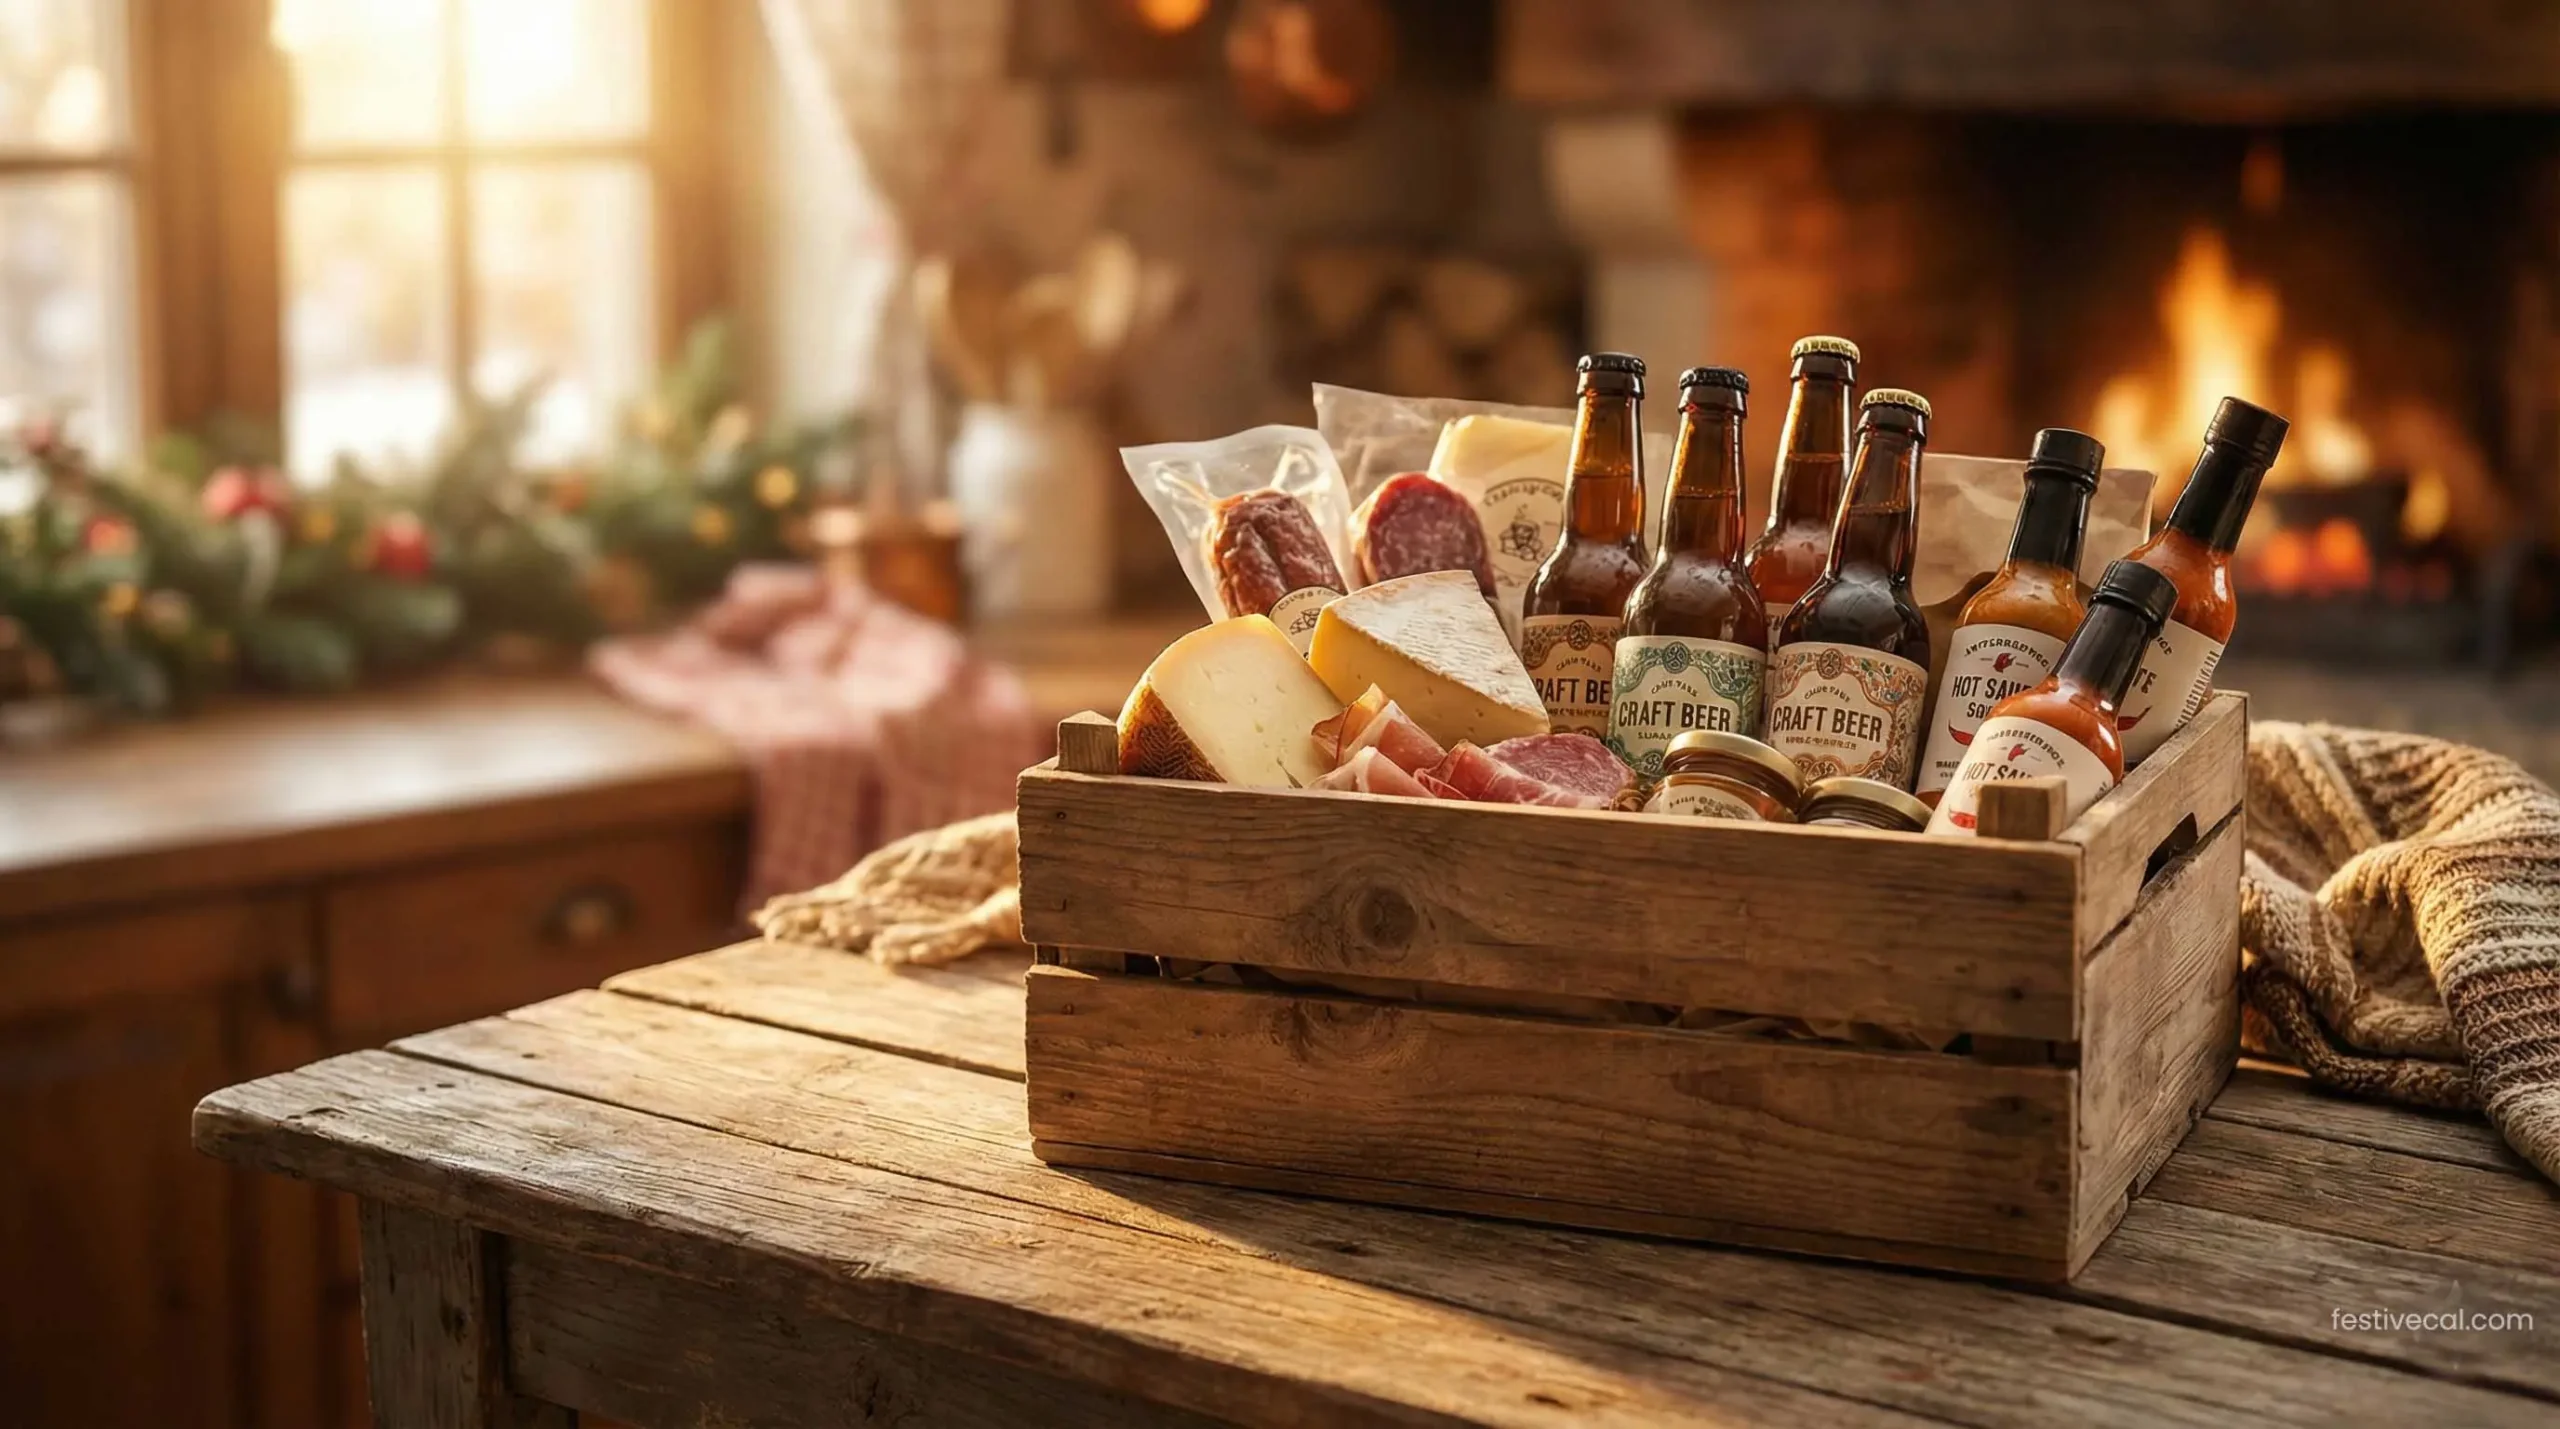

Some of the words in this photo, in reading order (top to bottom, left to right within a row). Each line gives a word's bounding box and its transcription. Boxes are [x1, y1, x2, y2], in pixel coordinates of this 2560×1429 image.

[1951, 675, 1982, 699] HOT
[1618, 700, 1676, 728] CRAFT
[1680, 702, 1731, 731] BEER
[1772, 705, 1828, 733] CRAFT
[1831, 707, 1883, 743] BEER
[1962, 761, 1995, 781] HOT
